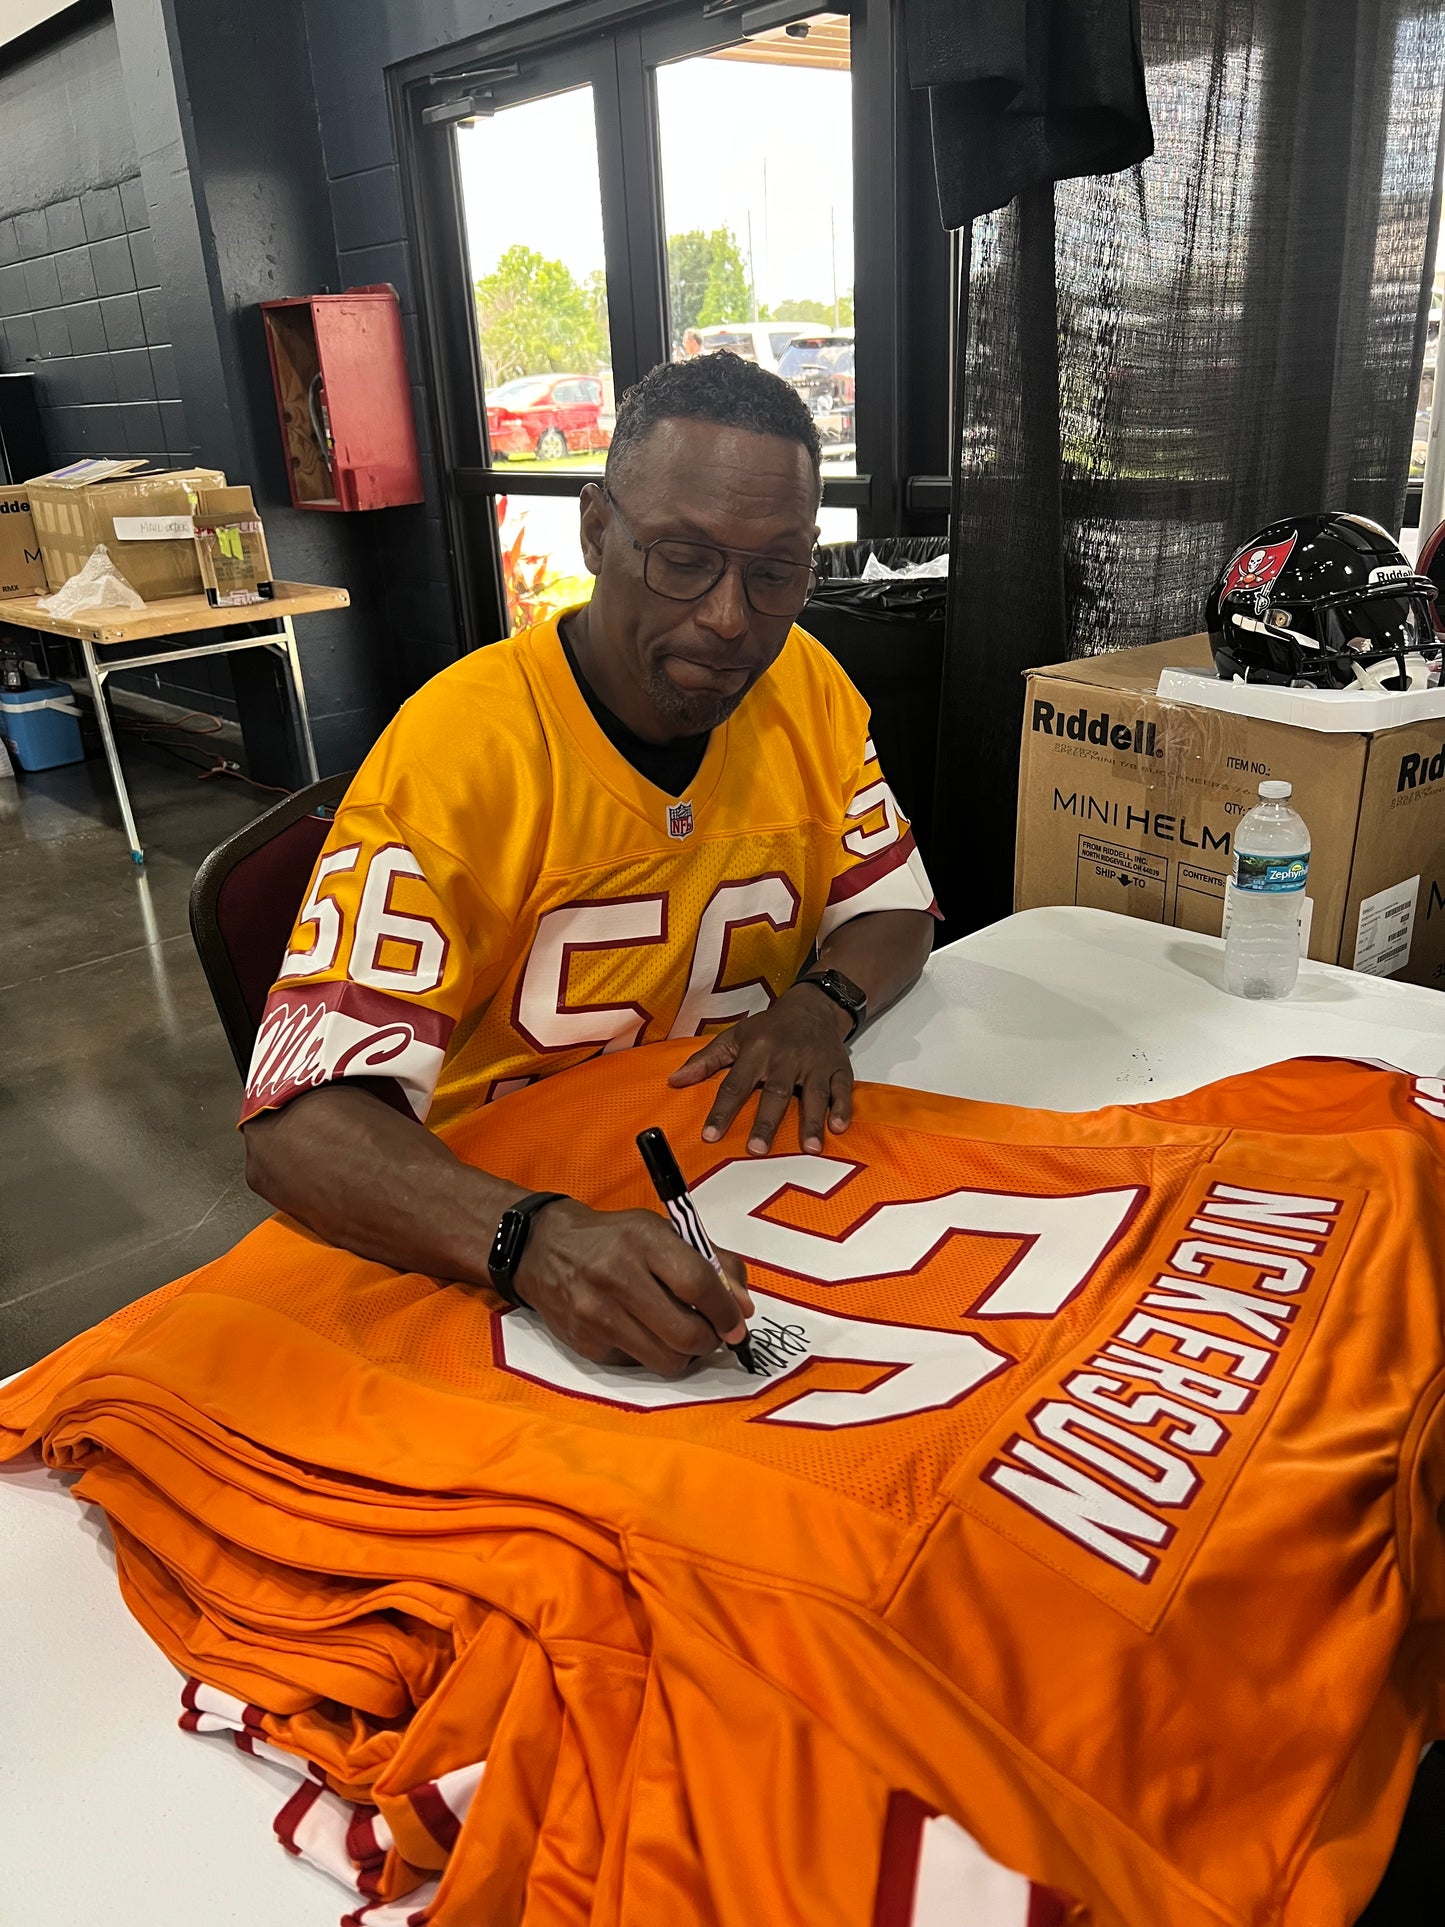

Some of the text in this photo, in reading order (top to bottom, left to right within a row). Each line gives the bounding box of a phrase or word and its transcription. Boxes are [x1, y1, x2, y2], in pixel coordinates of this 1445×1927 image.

[140, 522, 162, 533] MAIL
[2, 584, 20, 593] RMX
[1032, 699, 1157, 758] Riddell
[1088, 753, 1116, 767] MINI
[1226, 756, 1250, 772] ITEM
[1224, 801, 1247, 817] QTY:
[671, 816, 692, 835] NFL
[1125, 805, 1231, 856] HELM
[1081, 849, 1101, 861] NORTH
[1132, 862, 1142, 873] OH
[1082, 841, 1148, 866] FROM RIDDELL, INC.
[1095, 866, 1146, 889] SHIP TO
[1182, 869, 1226, 888] CONTENTS:
[277, 841, 450, 996] 56
[509, 871, 802, 1055] 56
[978, 1180, 1345, 1585] NICKERSON
